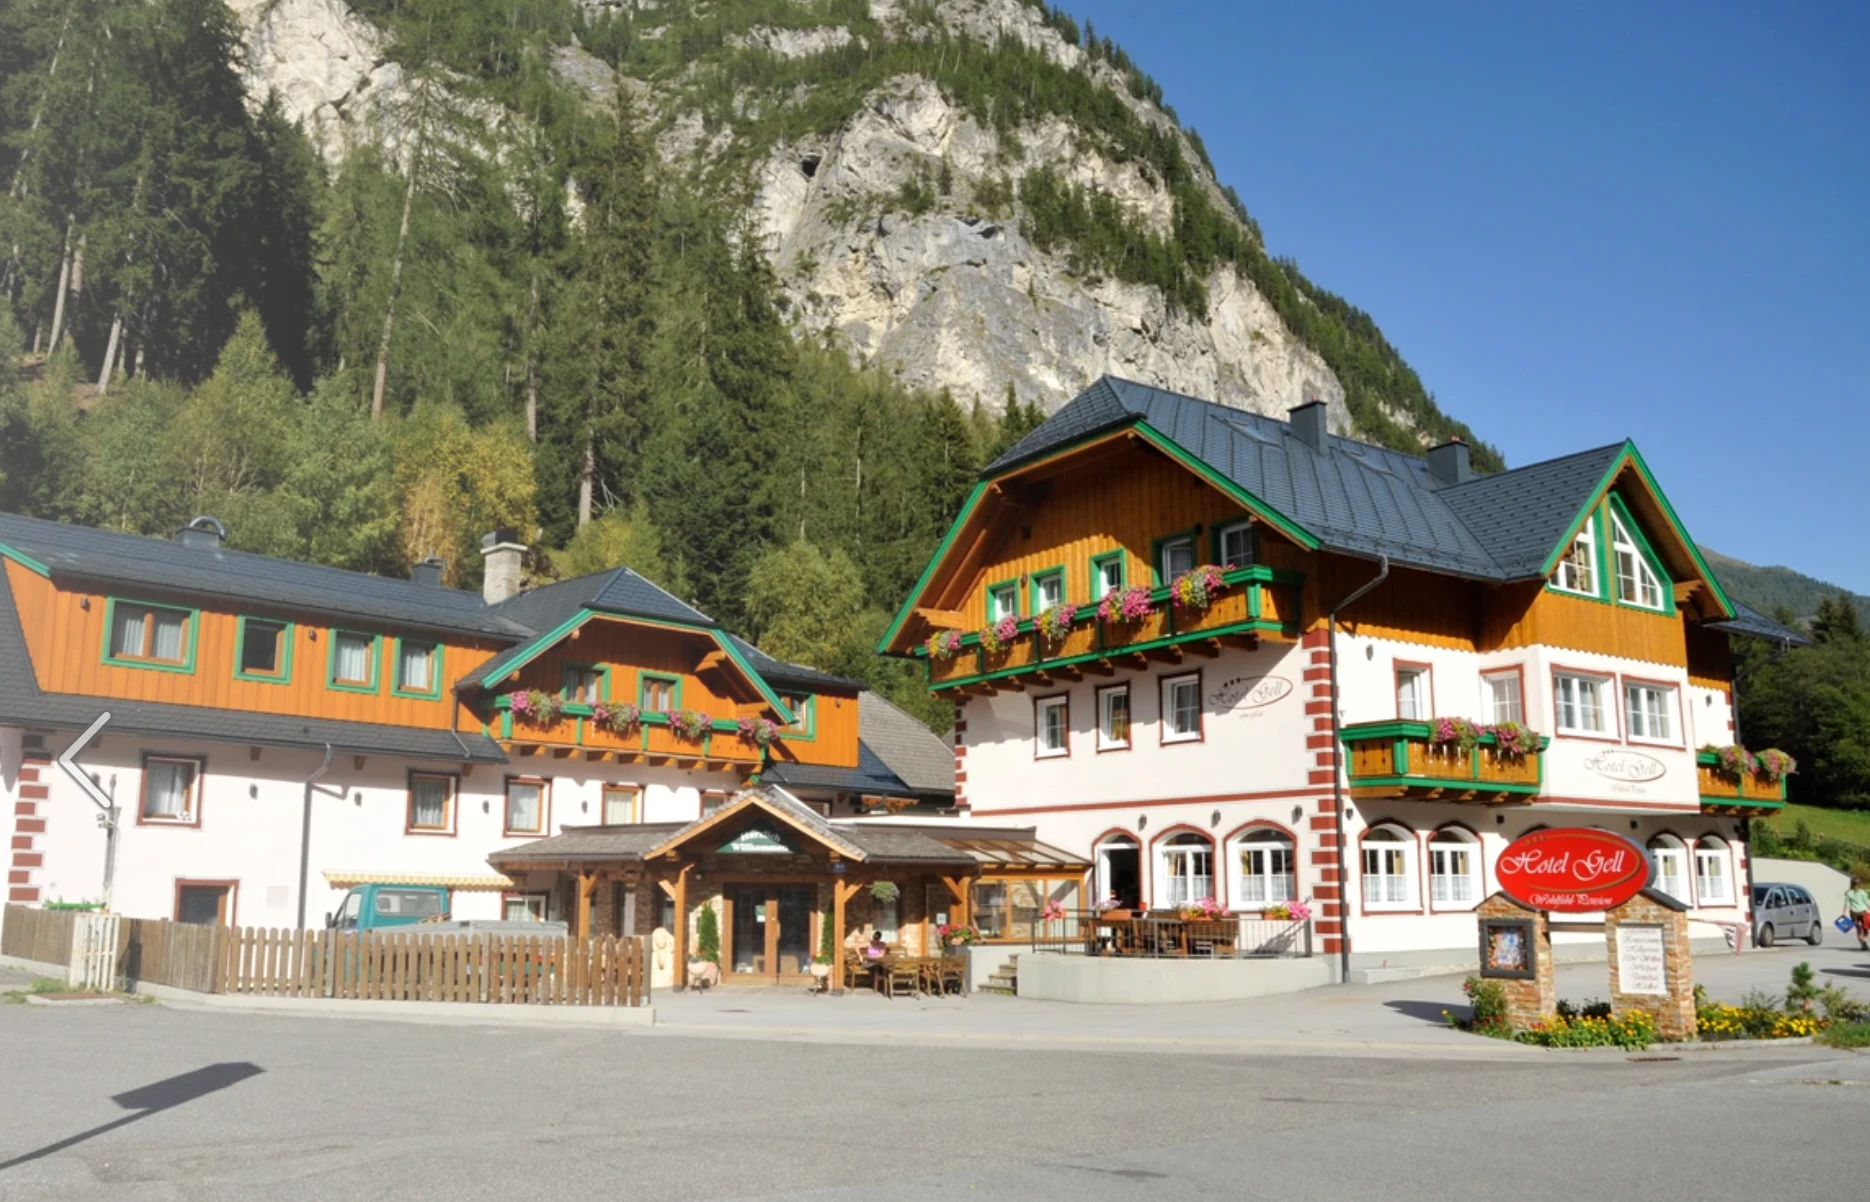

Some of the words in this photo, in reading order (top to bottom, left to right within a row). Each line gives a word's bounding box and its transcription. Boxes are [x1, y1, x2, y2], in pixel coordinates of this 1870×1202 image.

[1209, 686, 1248, 705] Hotel
[1584, 754, 1625, 772] Hotel
[1500, 849, 1569, 874] Hotel
[1573, 849, 1624, 881] Gell
